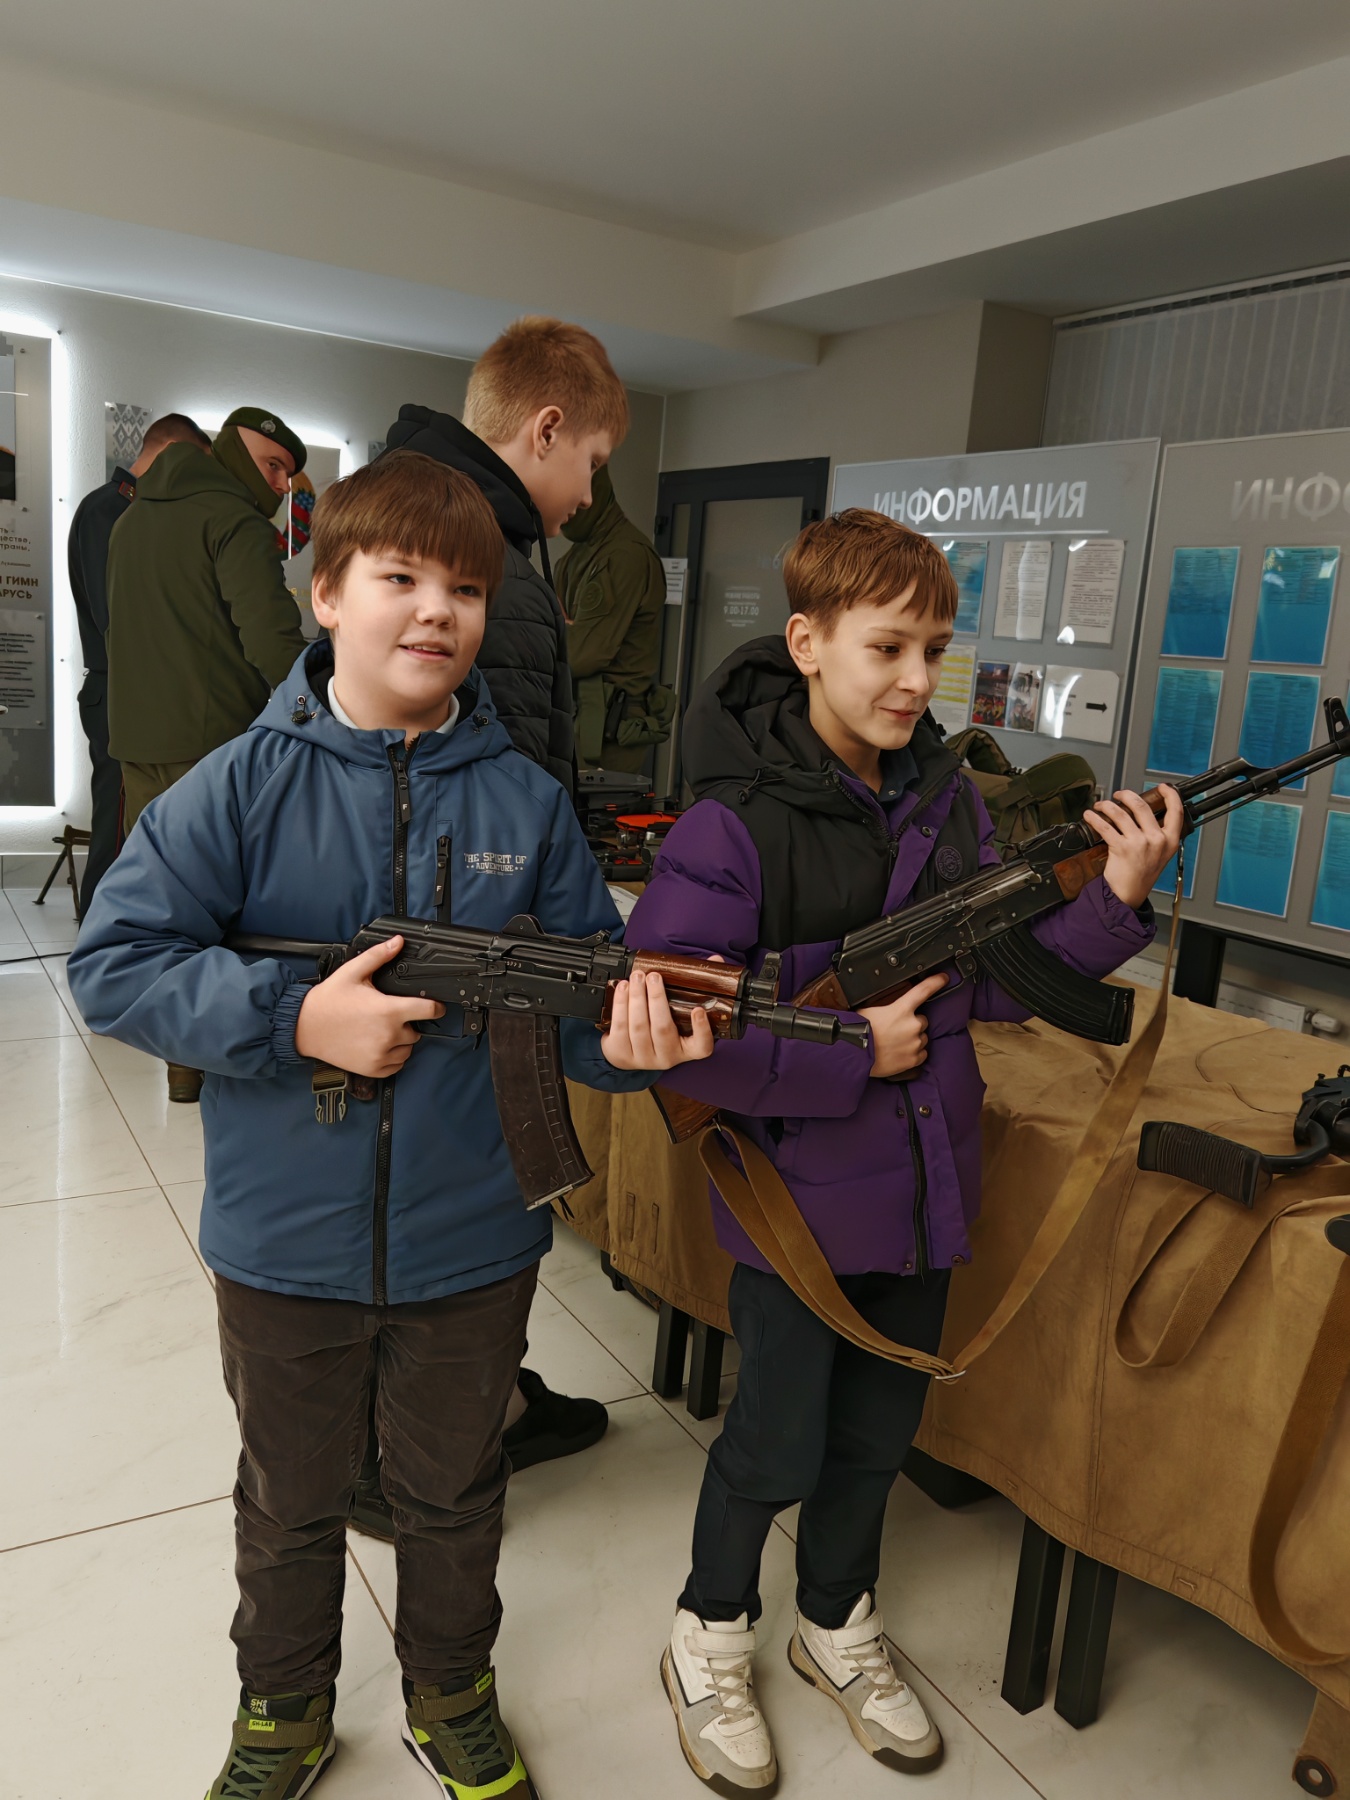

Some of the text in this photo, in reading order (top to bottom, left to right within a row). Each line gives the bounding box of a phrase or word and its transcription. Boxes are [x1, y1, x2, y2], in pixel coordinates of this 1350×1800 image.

[873, 481, 1087, 526] ИНФОРМАЦИЯ
[1231, 471, 1350, 522] ИНФ
[6, 576, 39, 587] ГИМН
[464, 852, 527, 864] THE SPIRIT OF
